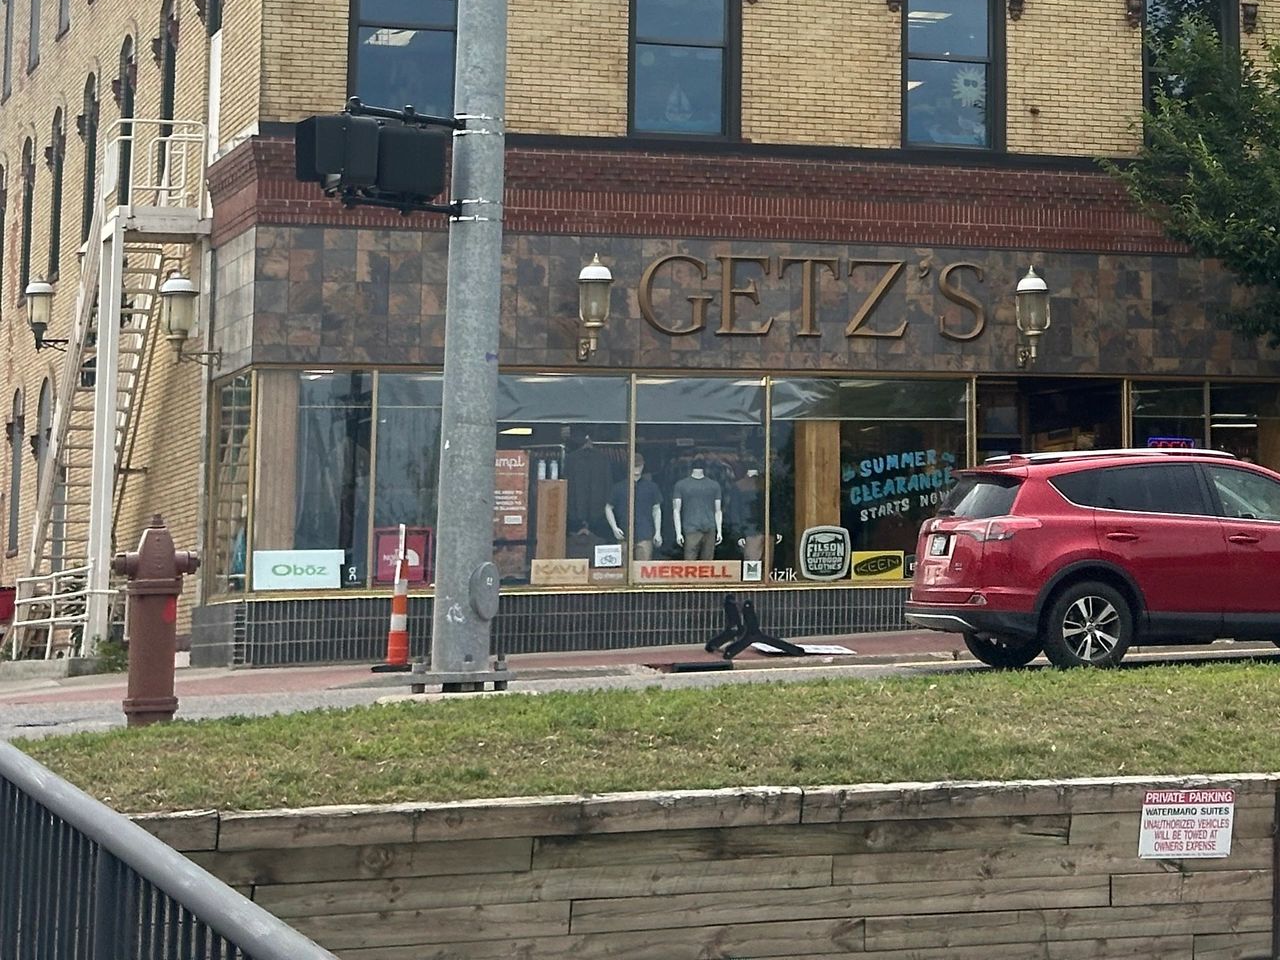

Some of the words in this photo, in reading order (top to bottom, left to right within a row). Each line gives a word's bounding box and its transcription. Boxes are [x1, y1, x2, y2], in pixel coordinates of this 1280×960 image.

[638, 254, 986, 341] GETZ'S
[860, 449, 937, 478] SUMMER
[850, 466, 955, 505] CLEARANCE
[860, 498, 910, 522] STARTS
[807, 543, 844, 557] FILSON
[535, 565, 586, 575] KAVU
[640, 565, 732, 579] MERRELL
[857, 558, 900, 573] KEEN
[1146, 792, 1185, 803] PRIVATE
[1189, 791, 1232, 803] PARKING
[1200, 806, 1229, 816] SUITES
[1144, 819, 1195, 830] UNAUTHORIZED
[1197, 818, 1229, 829] VEHICLES
[1154, 830, 1169, 840] WILL
[1172, 830, 1181, 840] BE
[1184, 830, 1207, 840] TOWED
[1209, 830, 1217, 839] AT
[1154, 841, 1183, 852] OWNERS
[1186, 840, 1216, 851] EXPENSE
